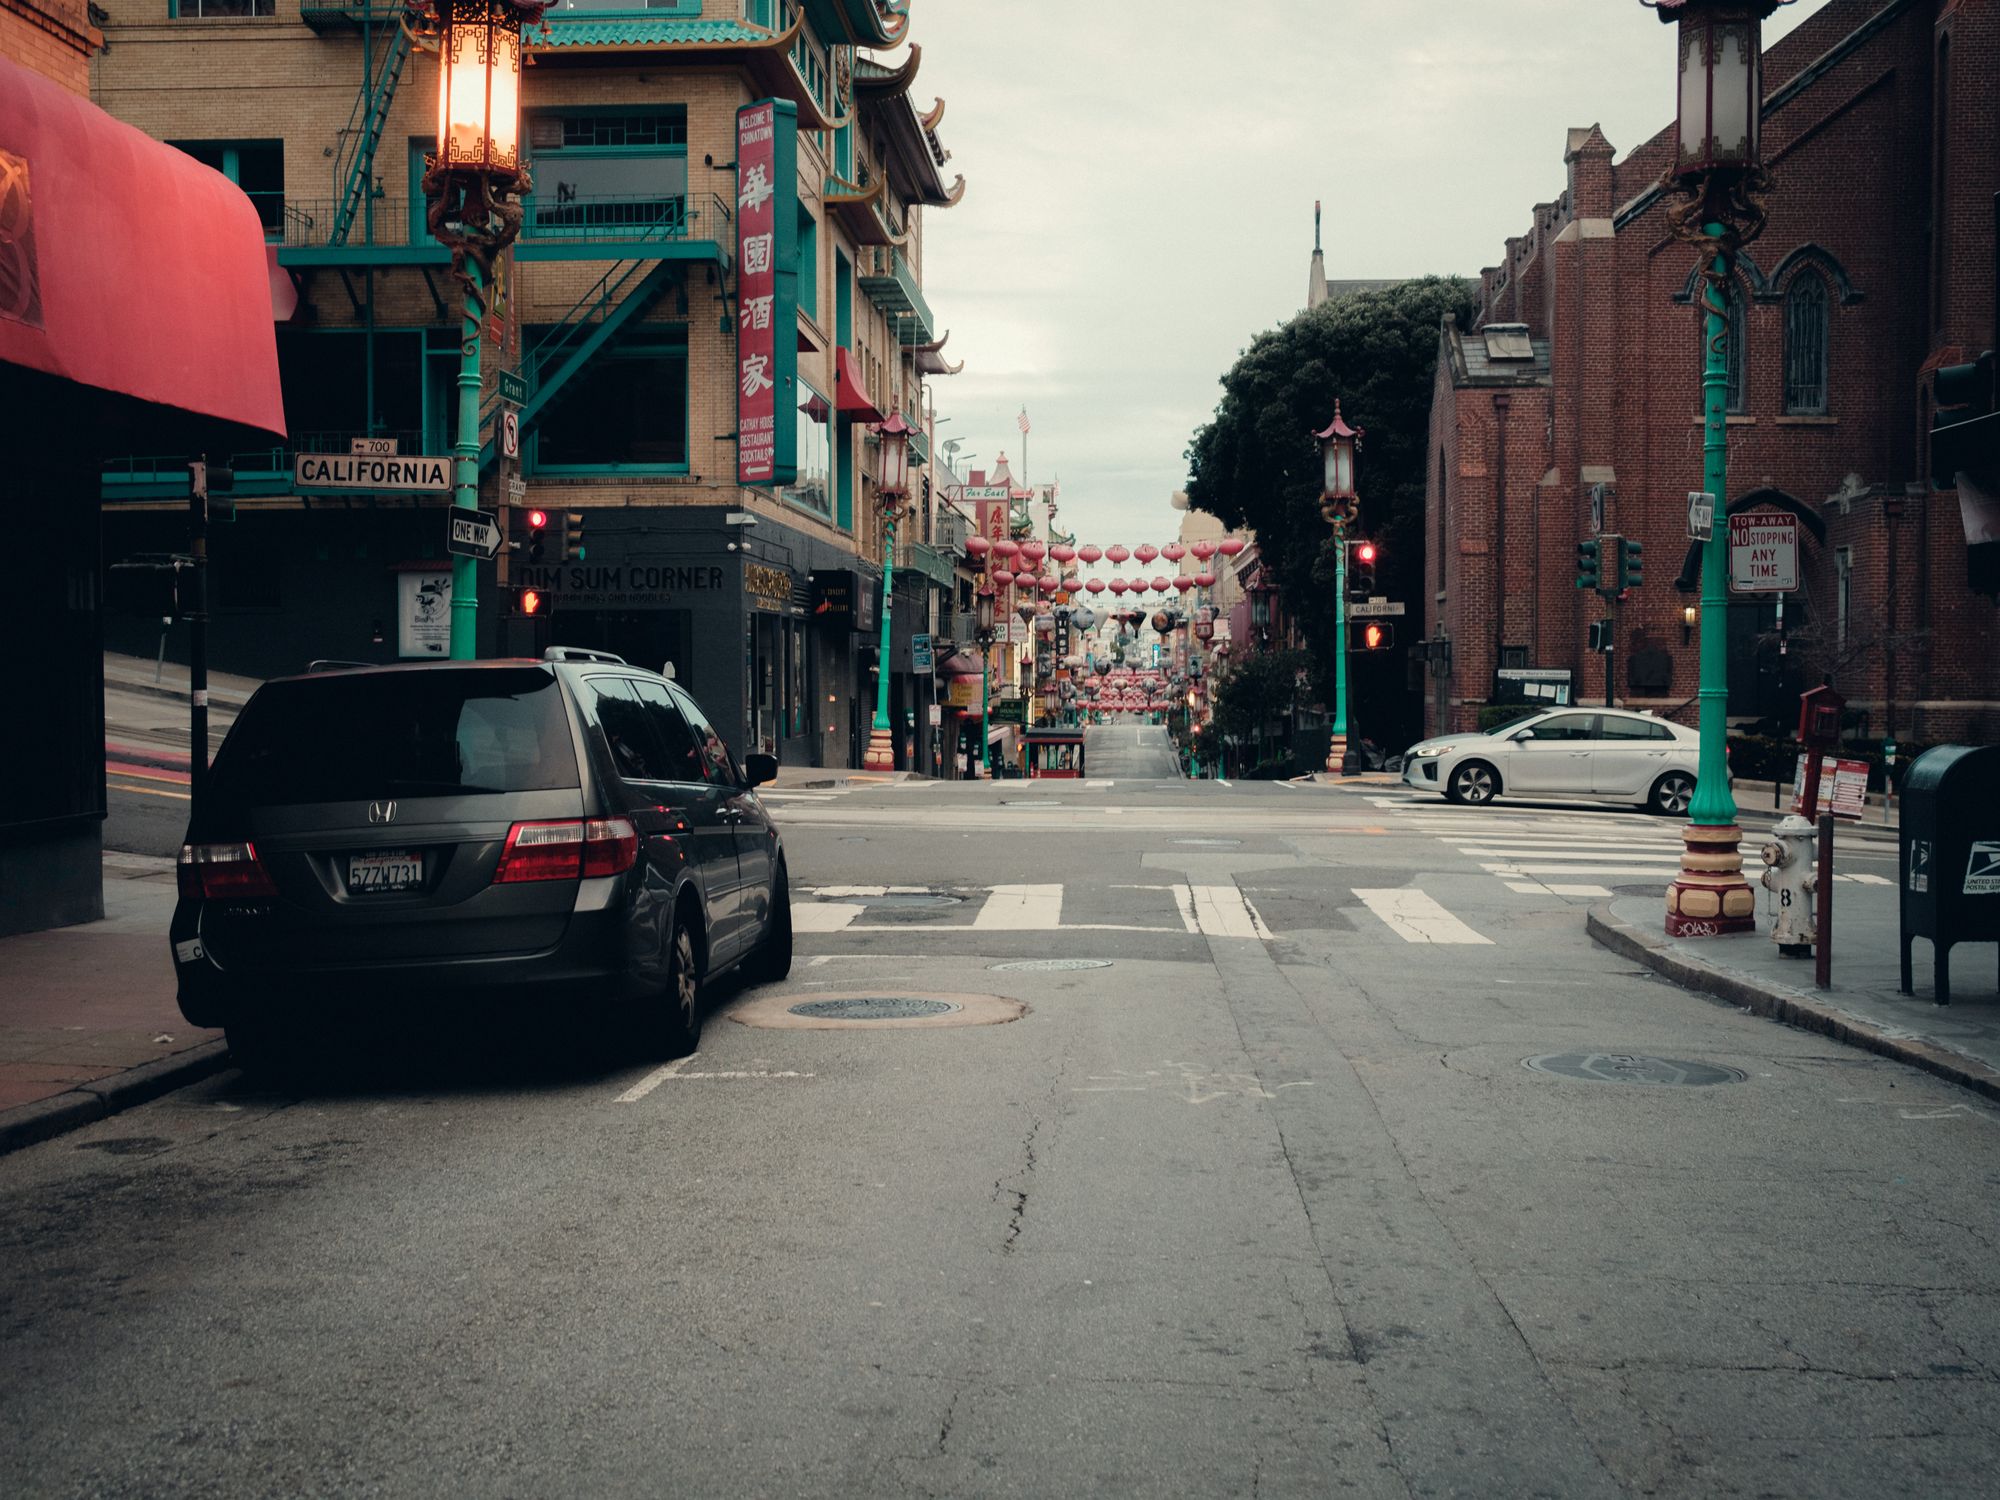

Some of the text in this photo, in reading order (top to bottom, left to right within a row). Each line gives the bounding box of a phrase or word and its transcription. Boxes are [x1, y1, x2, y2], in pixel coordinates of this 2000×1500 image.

[739, 109, 774, 130] WELCOME TO
[741, 127, 773, 146] CHINATOWN
[504, 379, 523, 399] Grant
[740, 415, 774, 432] CATHAY HOUSE
[368, 441, 390, 453] 700
[740, 431, 774, 448] RESTAURANT
[740, 449, 769, 463] COCKTAILS
[301, 459, 445, 484] CALIFORNIA
[965, 486, 1005, 497] Far East
[1733, 516, 1792, 526] TOW-AWAY
[454, 521, 490, 544] ONE WAY
[1732, 528, 1793, 546] NO STOPPING
[1751, 549, 1777, 561] ANY
[519, 567, 561, 590] DIM
[571, 567, 620, 589] SUM
[629, 567, 723, 589] CORNER
[1750, 564, 1778, 577] TIME
